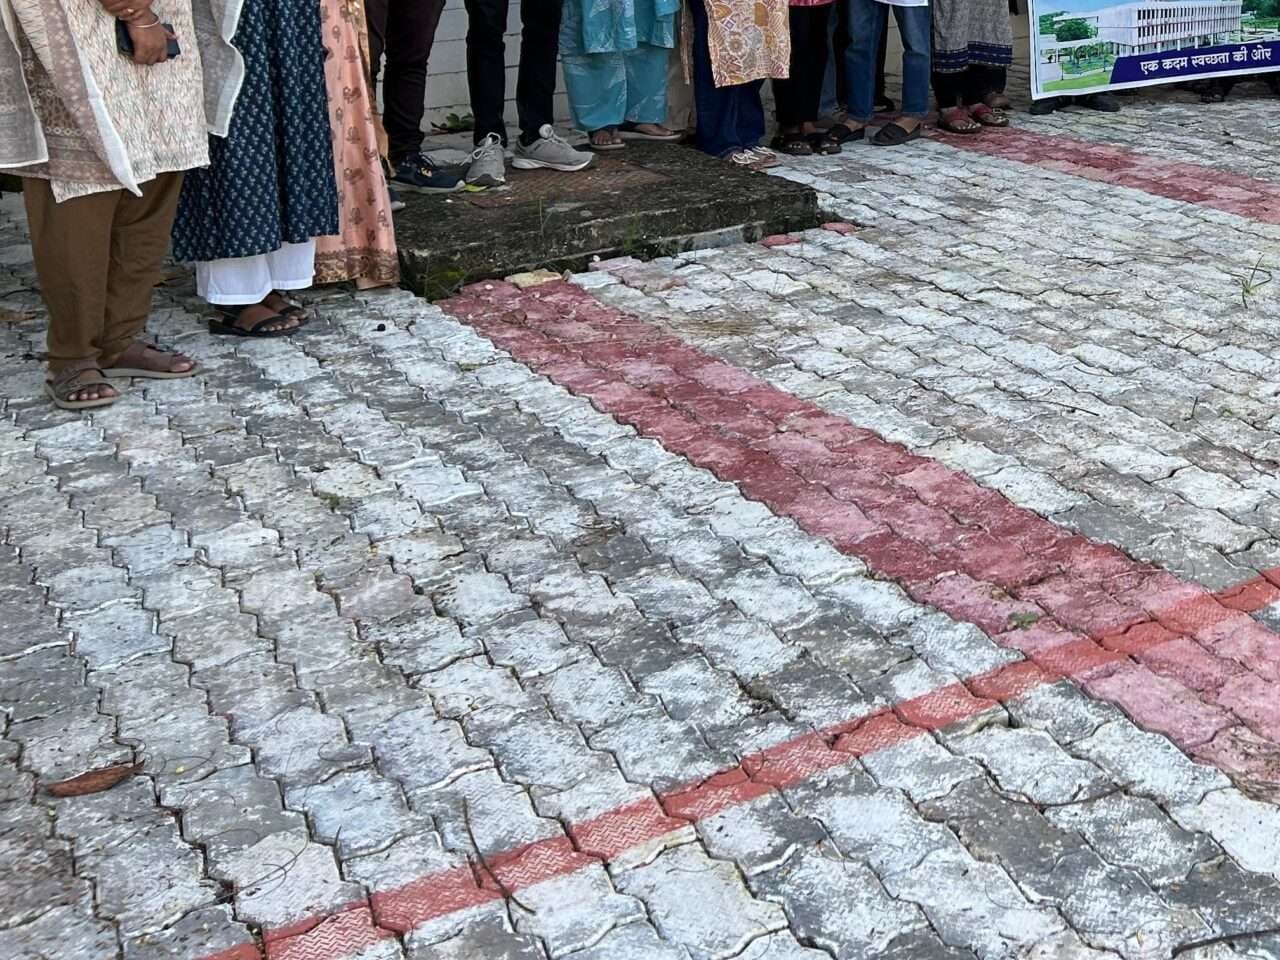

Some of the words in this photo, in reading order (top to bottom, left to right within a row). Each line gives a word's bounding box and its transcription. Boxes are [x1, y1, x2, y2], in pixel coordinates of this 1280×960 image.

[1140, 60, 1159, 75] एक
[1162, 56, 1188, 71] कदम
[1192, 53, 1230, 68] स्वच्छता
[1232, 46, 1249, 62] की
[1251, 44, 1272, 60] ओर
